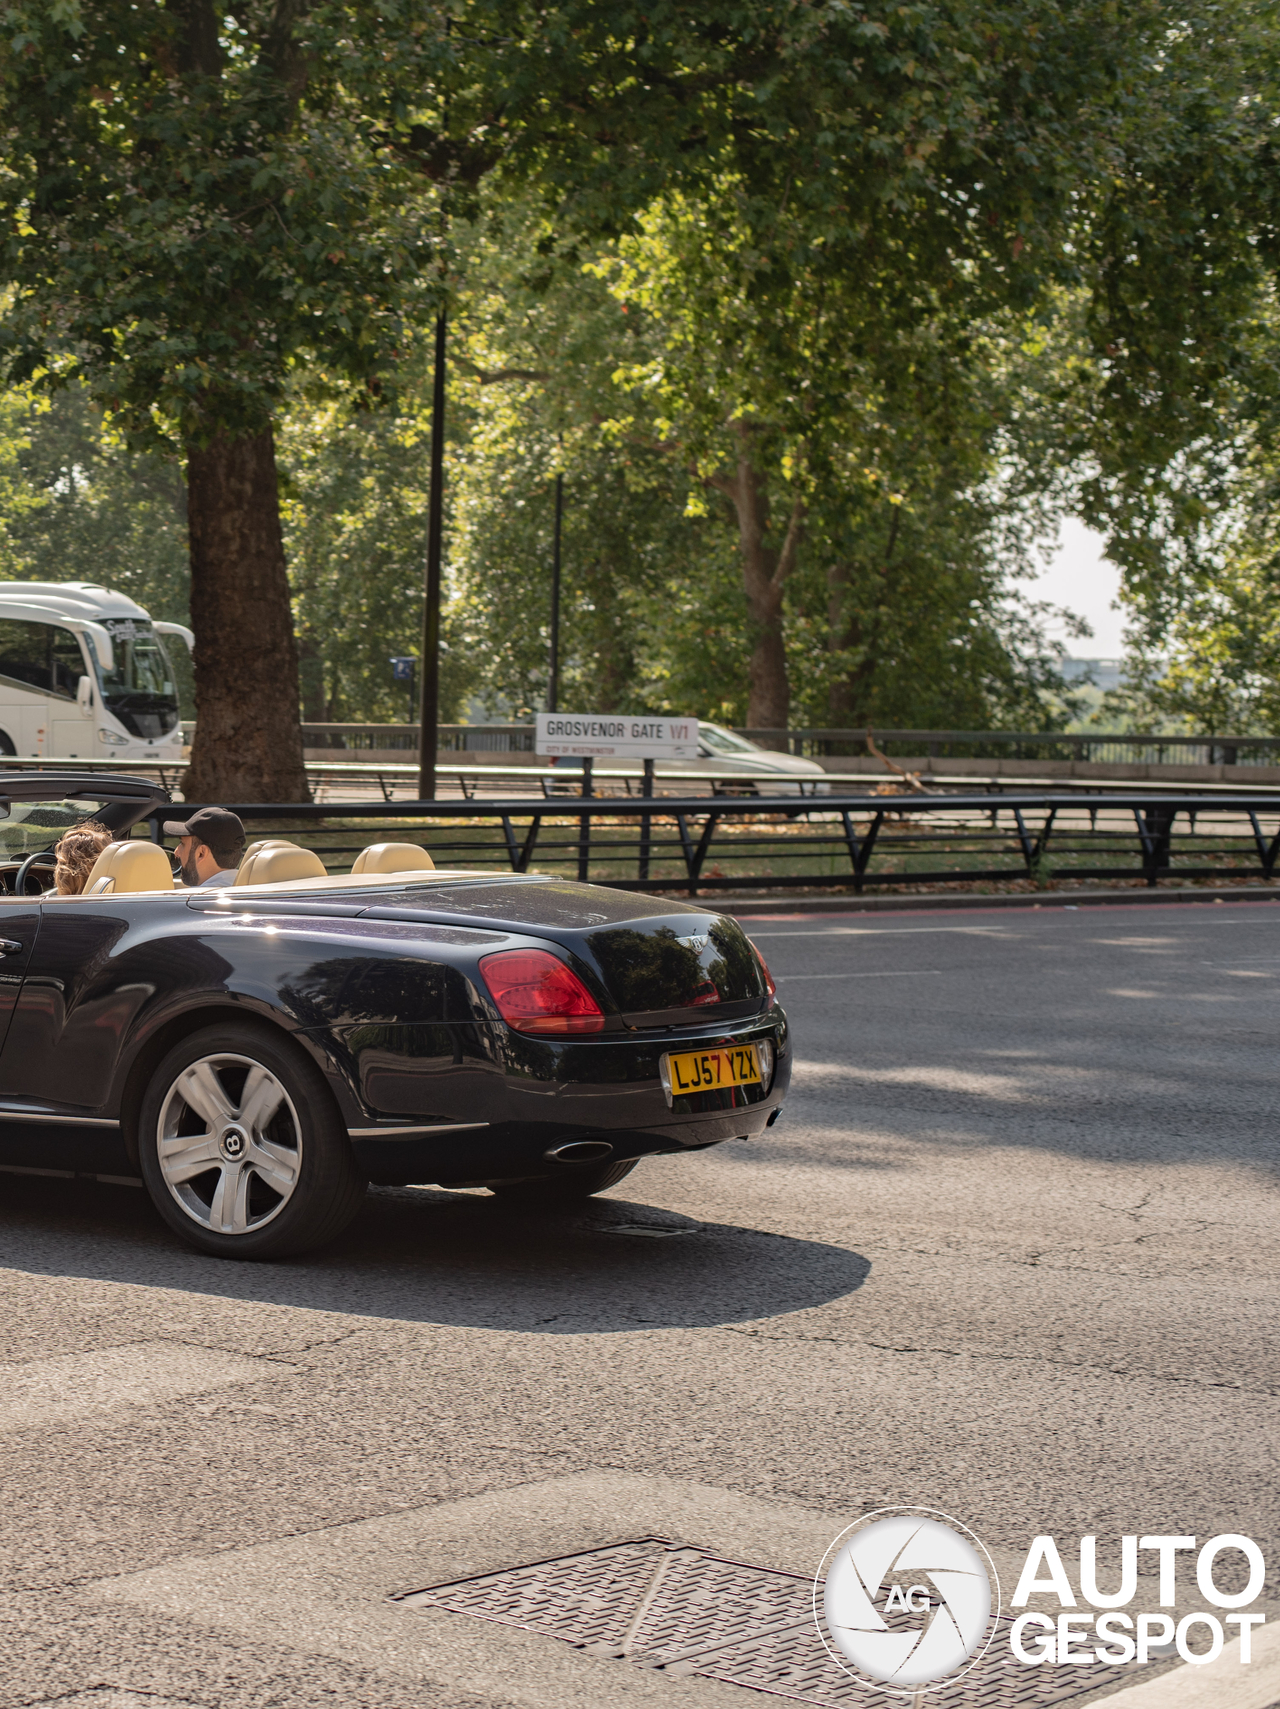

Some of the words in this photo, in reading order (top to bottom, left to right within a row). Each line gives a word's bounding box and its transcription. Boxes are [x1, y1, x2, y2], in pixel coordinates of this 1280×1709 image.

[547, 720, 624, 738] GROSVENOR
[631, 723, 663, 739] GATE
[670, 724, 689, 740] W1
[545, 745, 560, 753] CITY
[561, 746, 569, 754] OF
[571, 746, 615, 755] WESTMINSTER
[673, 1054, 720, 1090] LJ57
[725, 1050, 757, 1081] YZX
